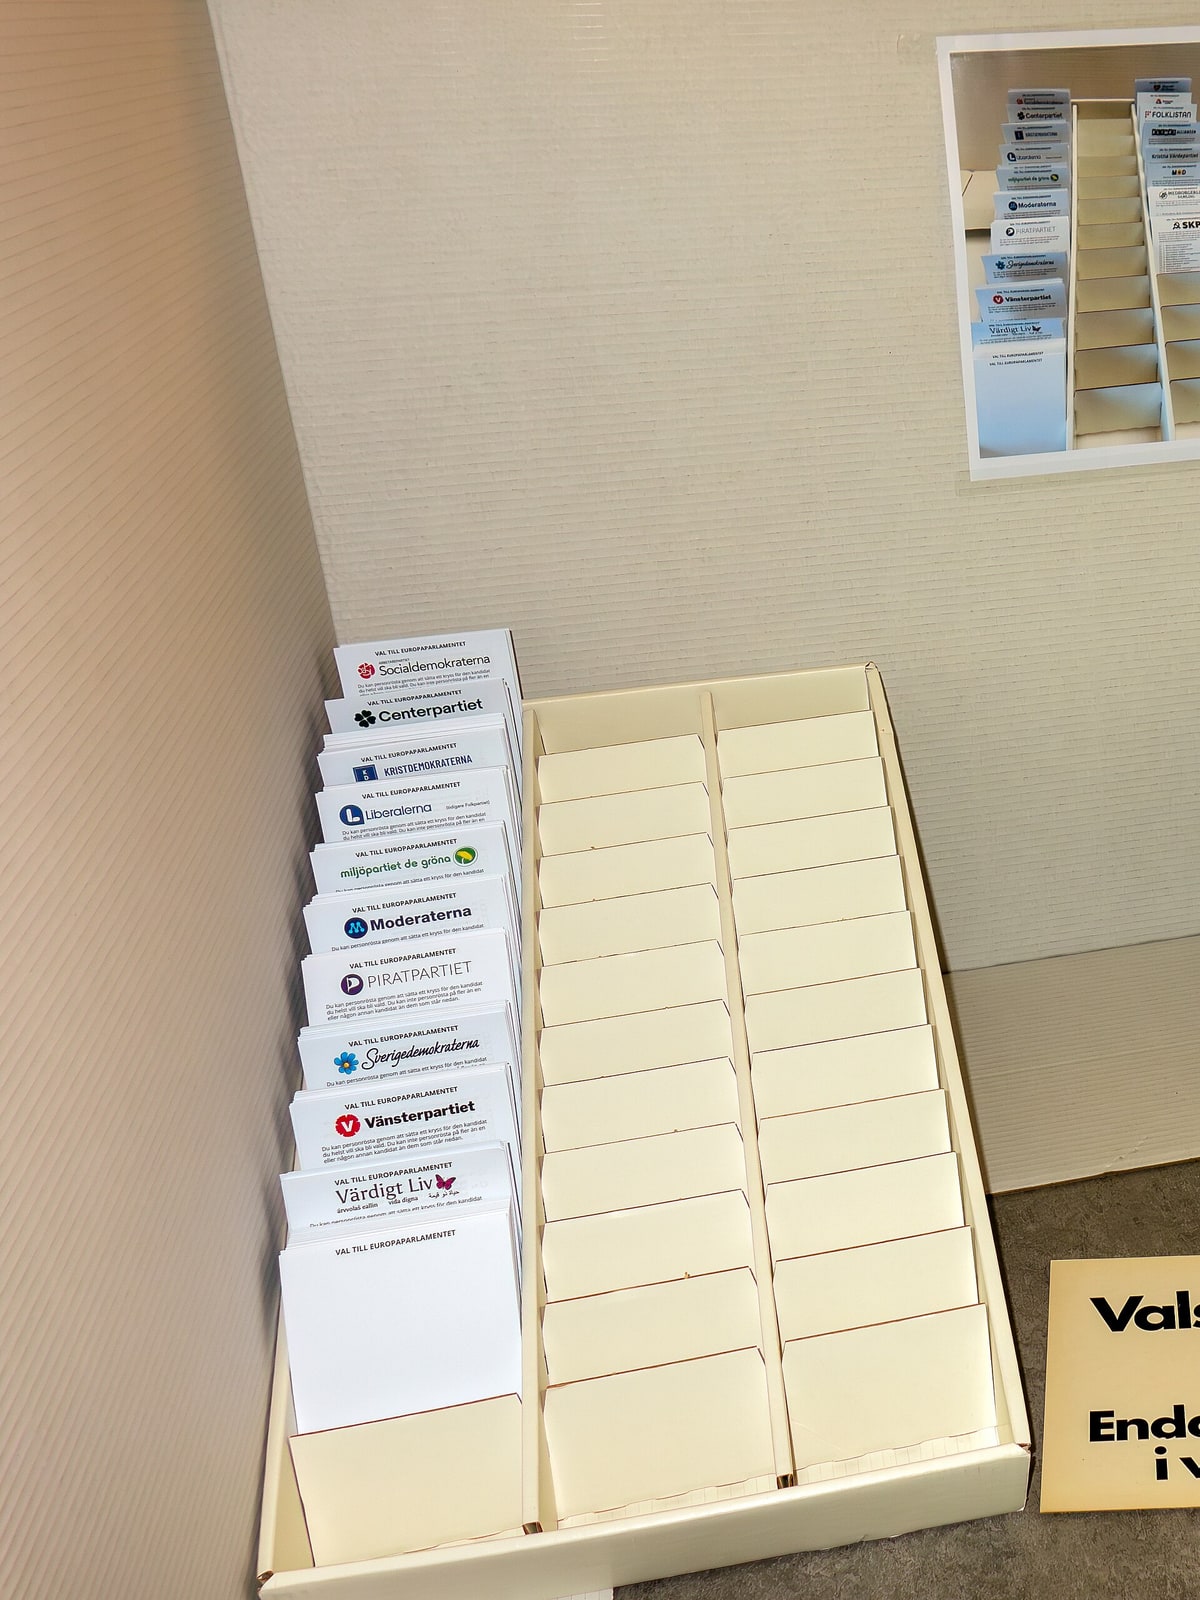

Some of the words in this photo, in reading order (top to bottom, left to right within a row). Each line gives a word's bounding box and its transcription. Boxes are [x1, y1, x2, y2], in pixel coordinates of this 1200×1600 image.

[400, 641, 466, 653] EUROPAPARLAMENTET
[379, 656, 490, 676] Socialdemokraterna
[394, 689, 462, 702] EUROPAPARLAMENTET
[379, 698, 483, 722] Centerpartiet
[388, 742, 456, 758] EUROPAPARLAMENTET
[384, 754, 472, 776] KRISTDEMOKRATERNA
[390, 782, 460, 795] EUROPAPARLAMENTET
[365, 805, 432, 819] Liberalerna
[384, 838, 457, 853] EUROPAPARLAMENTET
[340, 861, 402, 879] miljöpartiet
[404, 858, 418, 869] de
[421, 855, 451, 869] gröna
[382, 893, 456, 908] EUROPAPARLAMENTET
[370, 907, 472, 931] Moderaterna
[379, 948, 456, 964] EUROPAPARLAMENTET
[368, 961, 472, 988] PIRATPARTIET
[379, 1025, 458, 1042] EUROPAPARLAMENTET
[361, 1038, 479, 1070] Sverigedemokraterna
[376, 1086, 457, 1104] EUROPAPARLAMENTET
[364, 1101, 475, 1129] Vänsterpartiet
[368, 1162, 452, 1180] EUROPAPARLAMENTET
[335, 1182, 403, 1204] Värdigt
[409, 1177, 432, 1192] Liv
[369, 1229, 456, 1249] EUROPAPARLAMENTET
[1154, 1446, 1168, 1480] i
